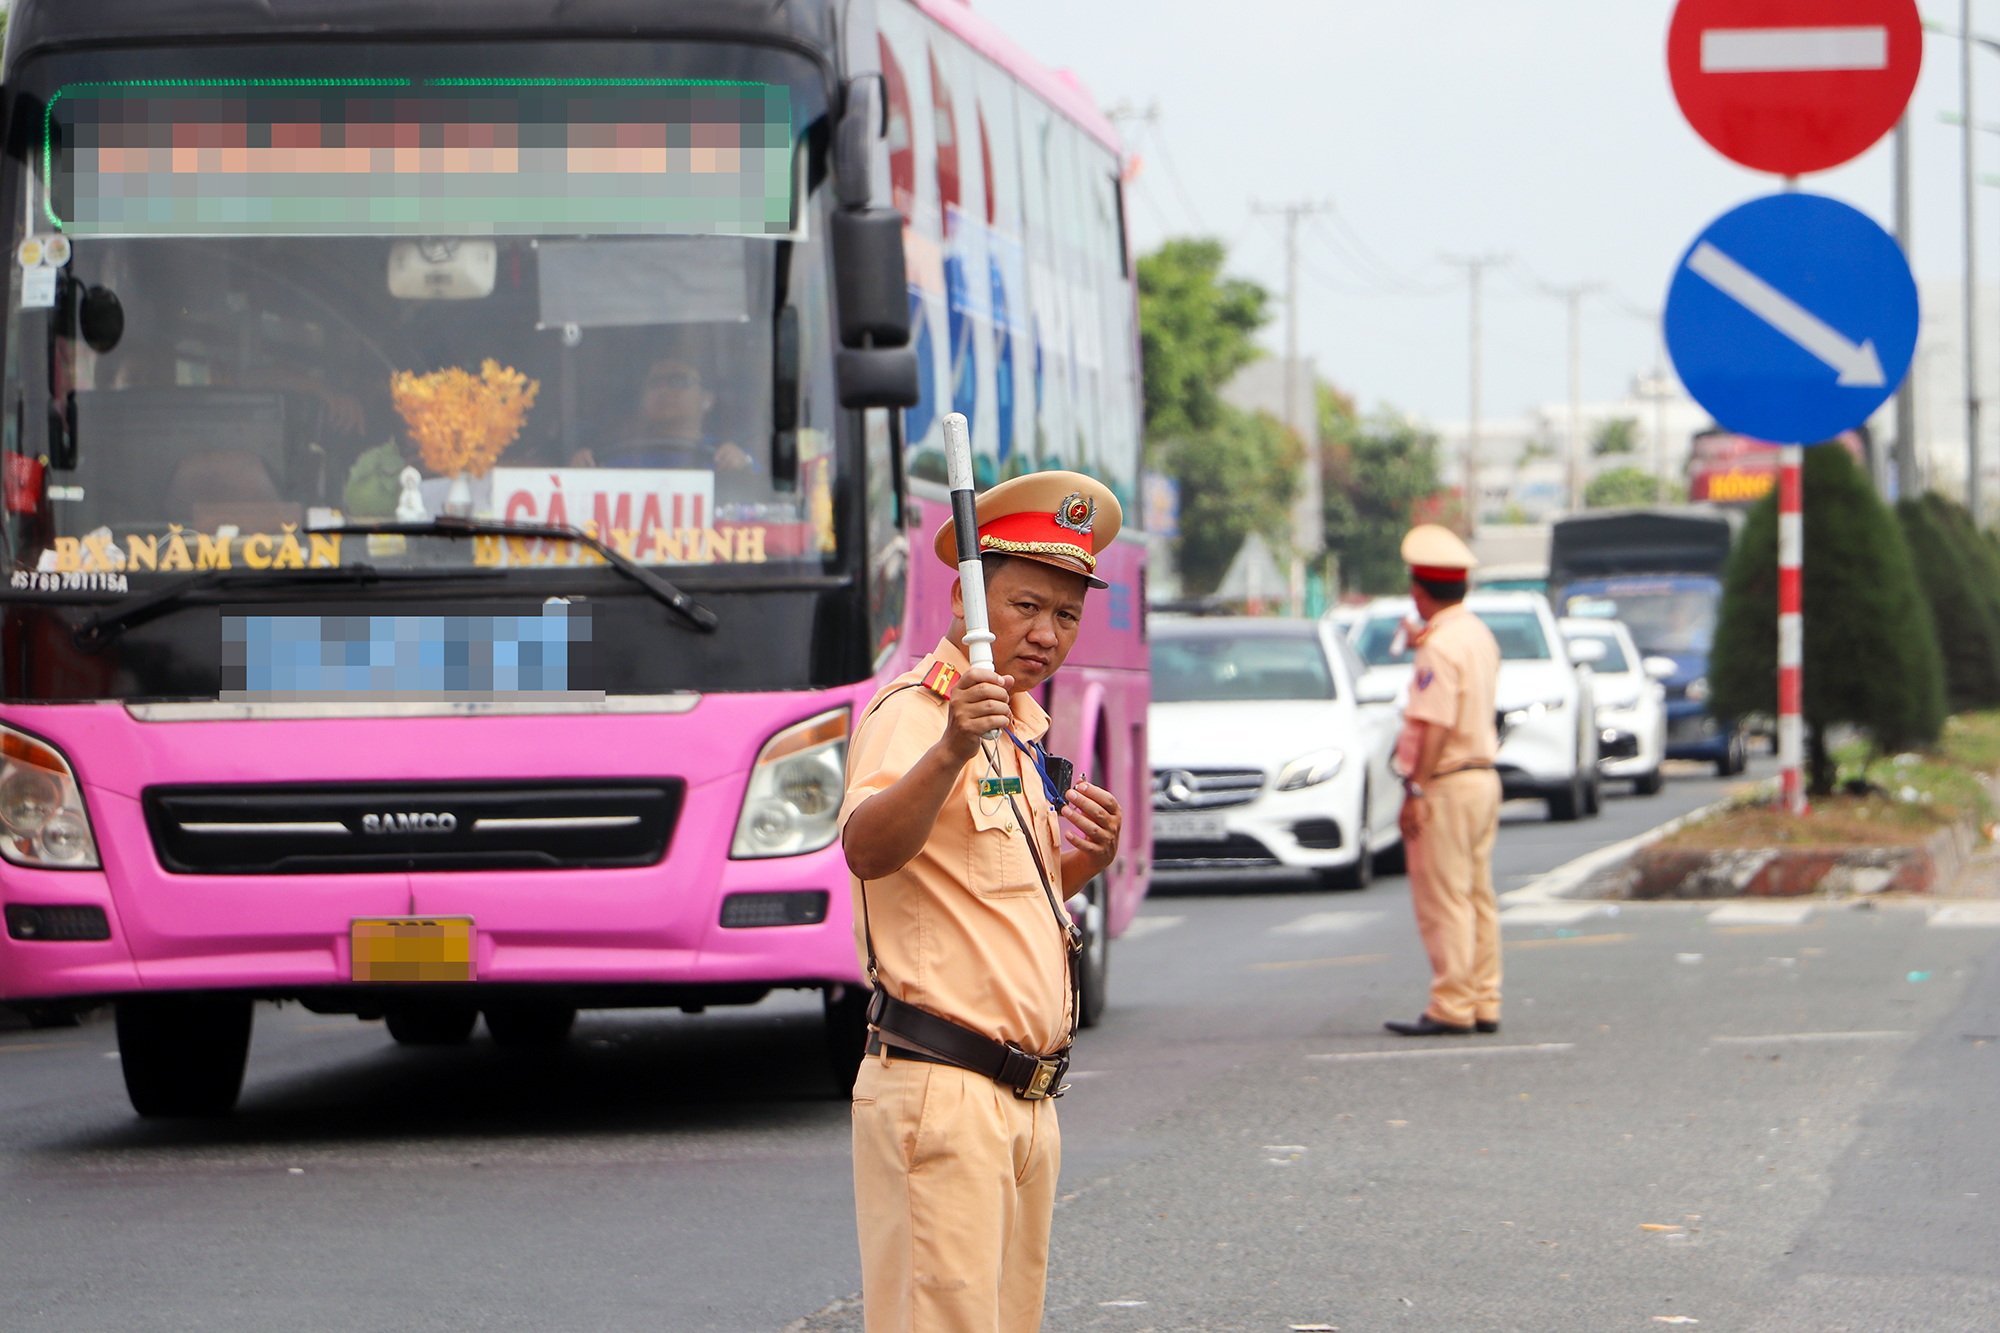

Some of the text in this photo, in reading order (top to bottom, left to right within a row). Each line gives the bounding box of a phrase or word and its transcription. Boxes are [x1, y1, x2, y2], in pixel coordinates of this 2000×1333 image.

[243, 521, 342, 570] CĂN
[654, 526, 767, 564] NINH
[362, 812, 458, 834] SAMCO
